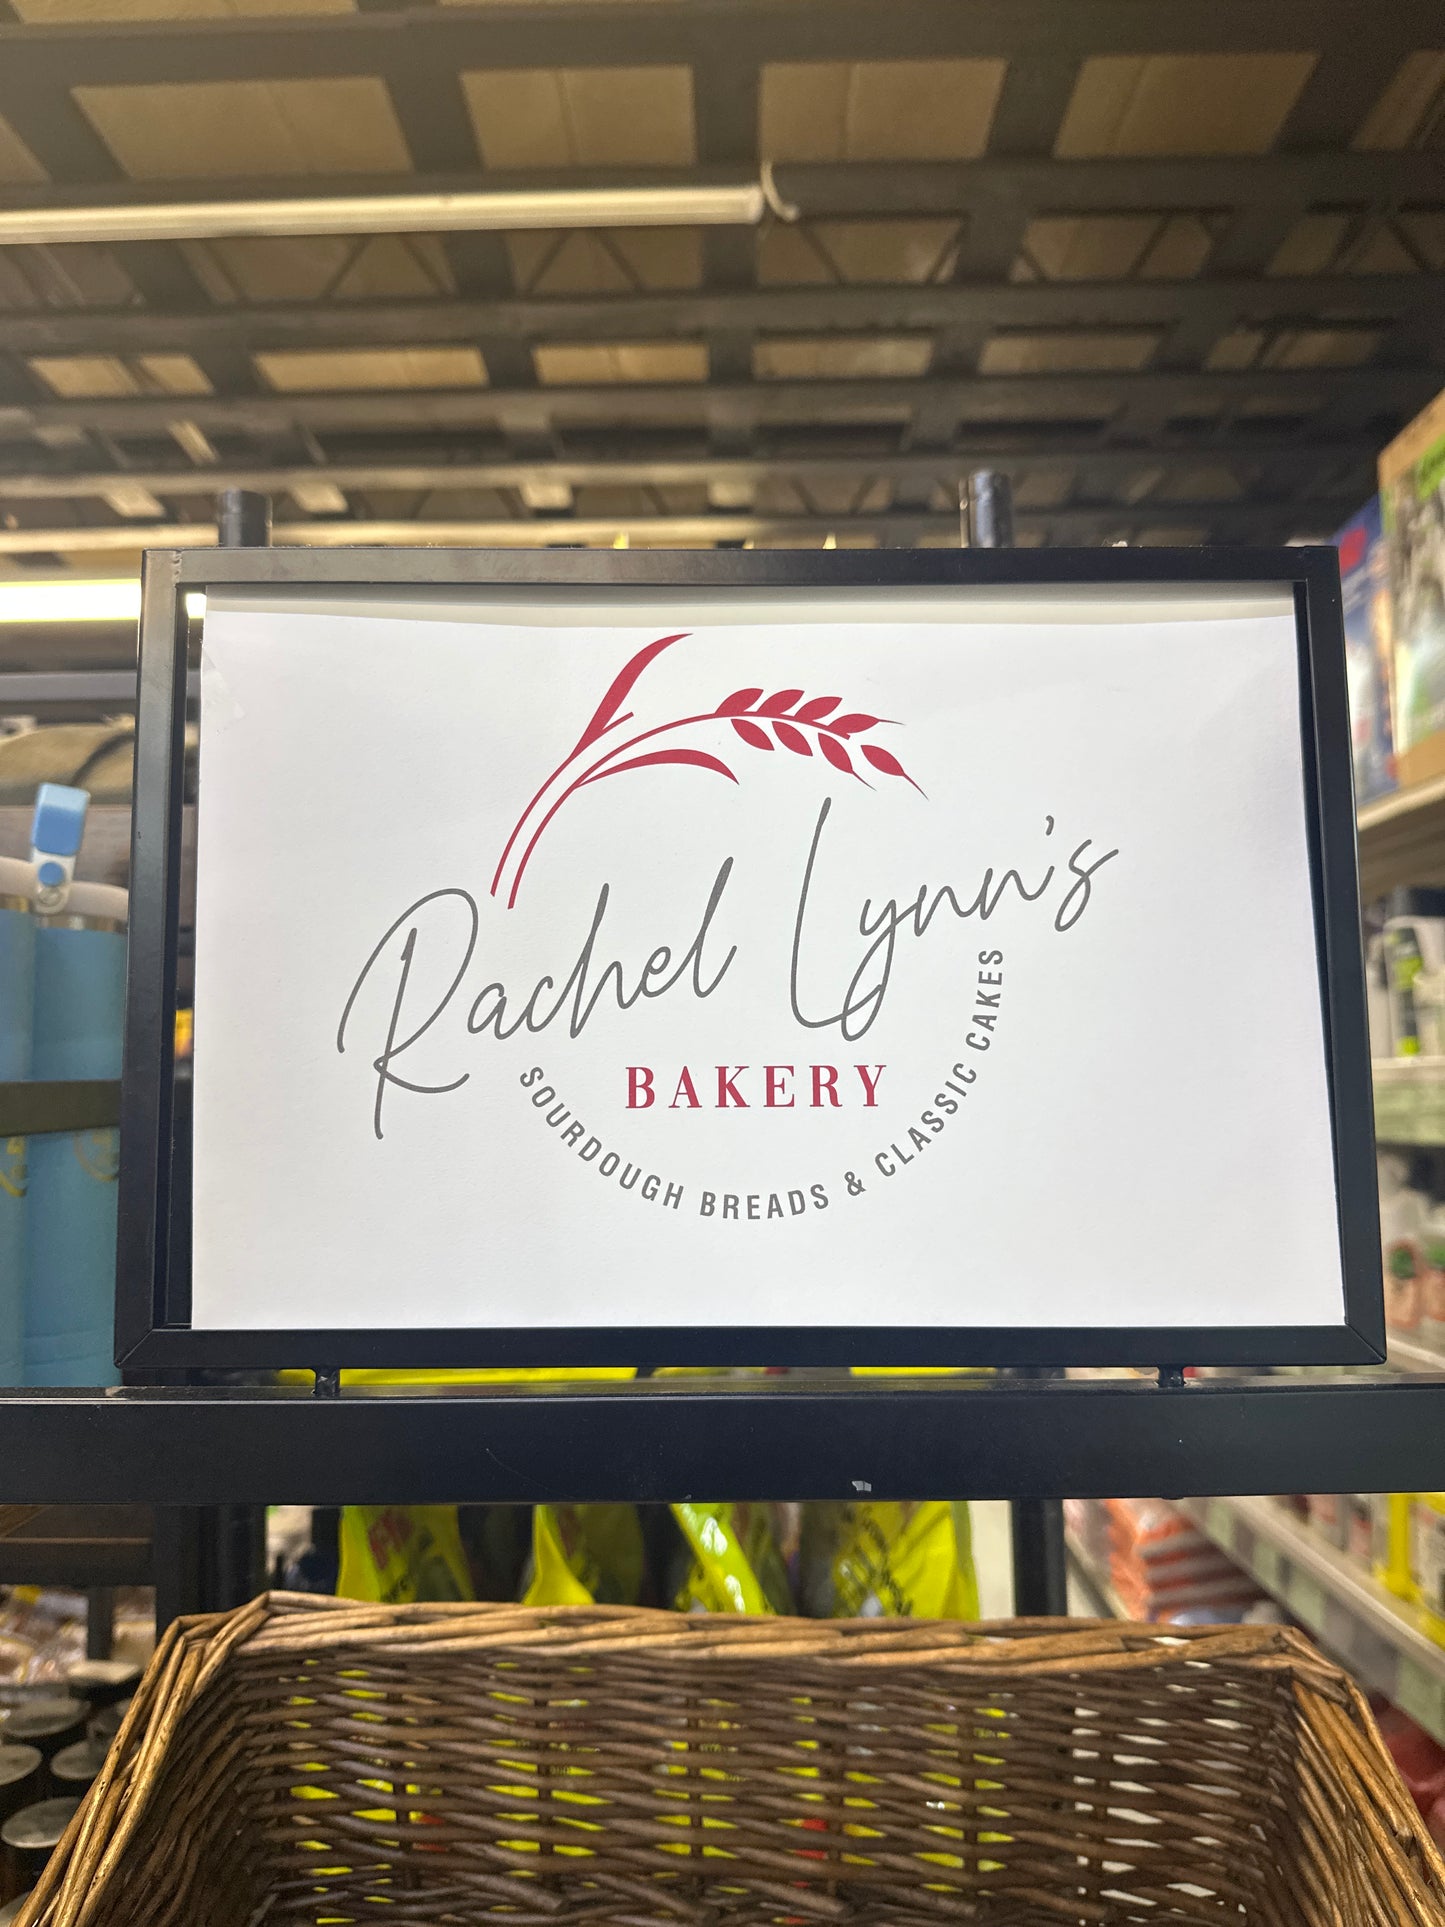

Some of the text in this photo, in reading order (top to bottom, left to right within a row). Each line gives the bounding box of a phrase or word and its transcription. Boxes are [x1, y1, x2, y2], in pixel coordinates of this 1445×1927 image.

[336, 797, 1120, 1140] Rachel Lynn's
[519, 949, 1004, 1220] SOURDOUGH BREADS & CLASSIC CAKES
[624, 1064, 887, 1109] BAKERY
